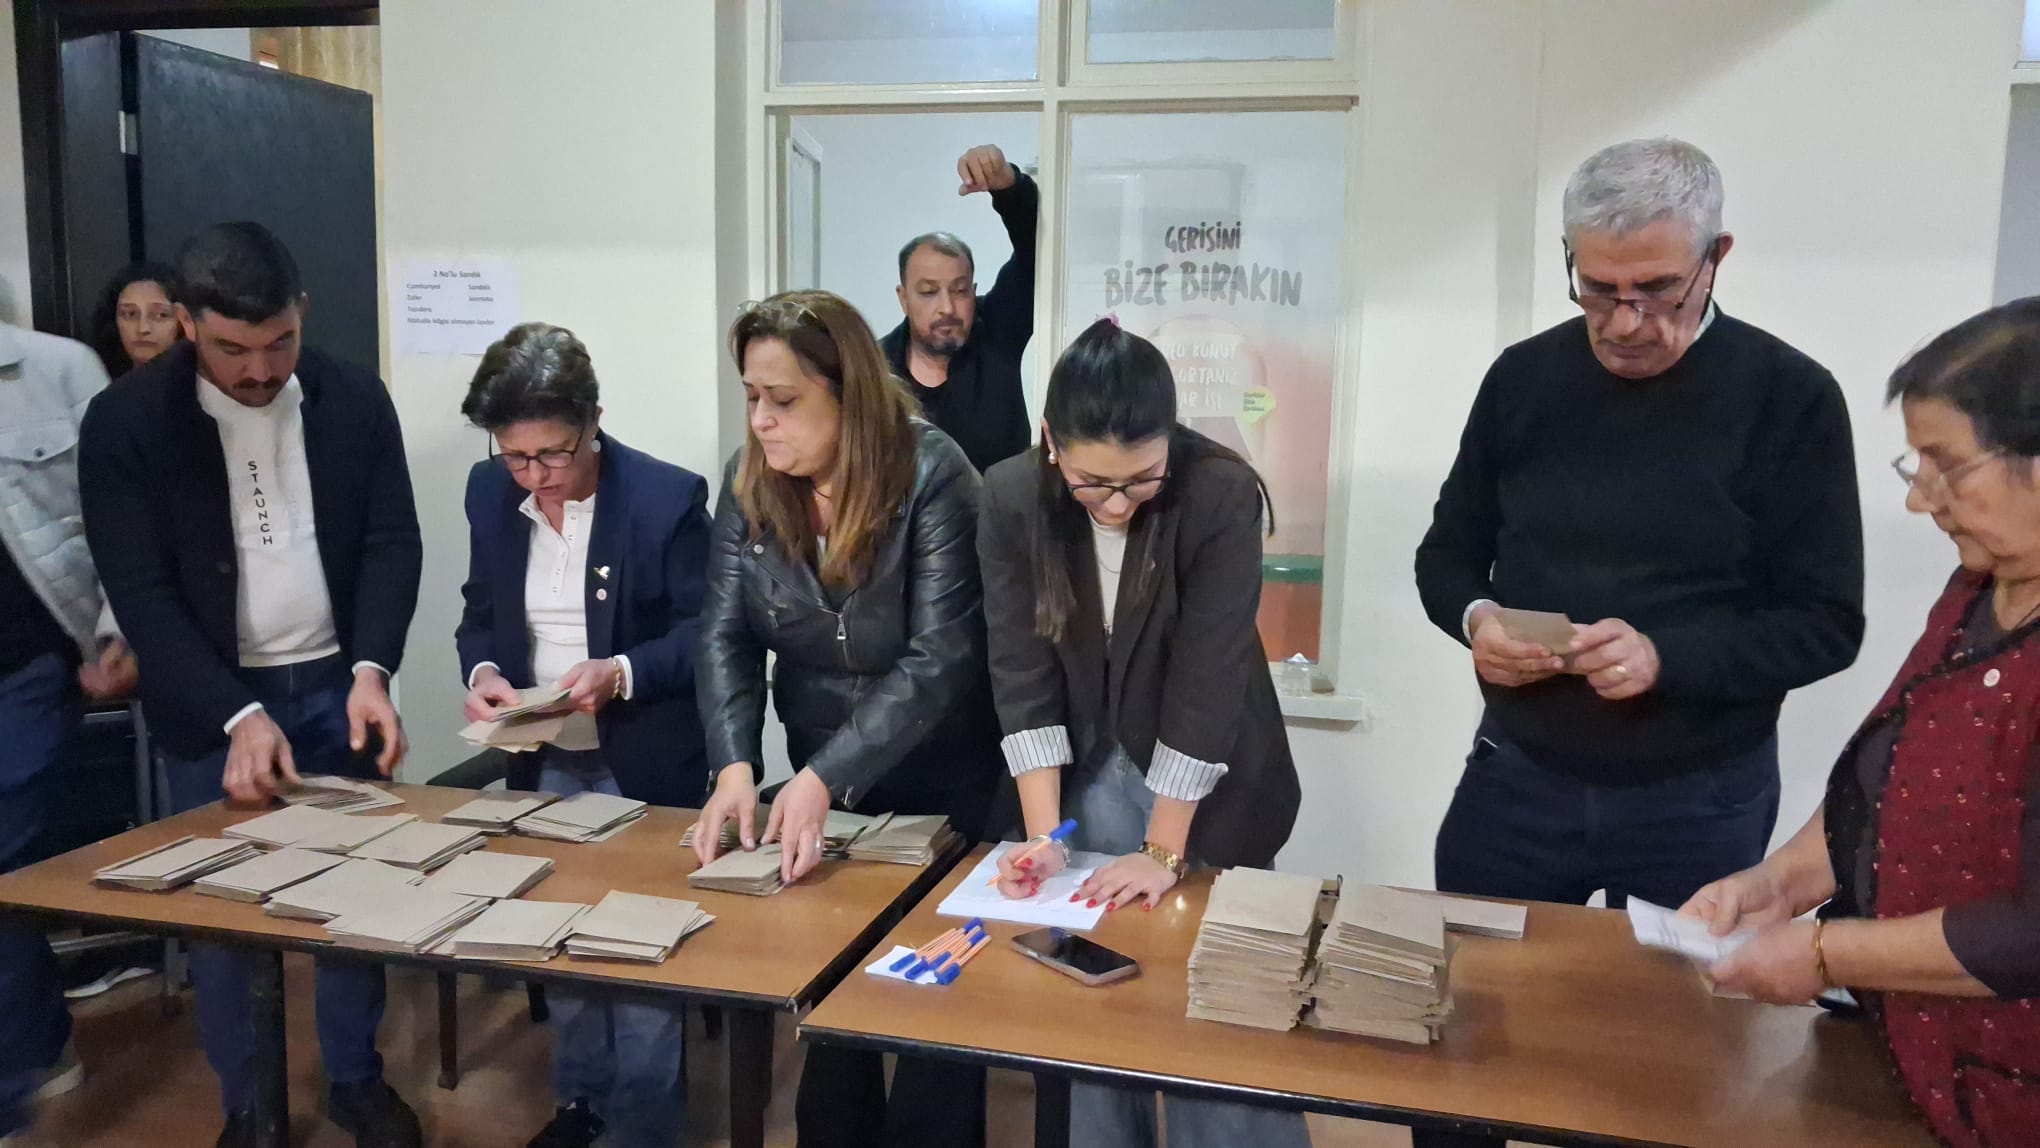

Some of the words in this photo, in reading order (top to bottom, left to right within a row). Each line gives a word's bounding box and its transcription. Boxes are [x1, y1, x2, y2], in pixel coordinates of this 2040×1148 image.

[1164, 220, 1241, 253] GERİSİNİ
[1103, 259, 1169, 309] BİZE
[1178, 260, 1303, 307] BIRAKIN
[247, 461, 273, 545] STAUNCH
